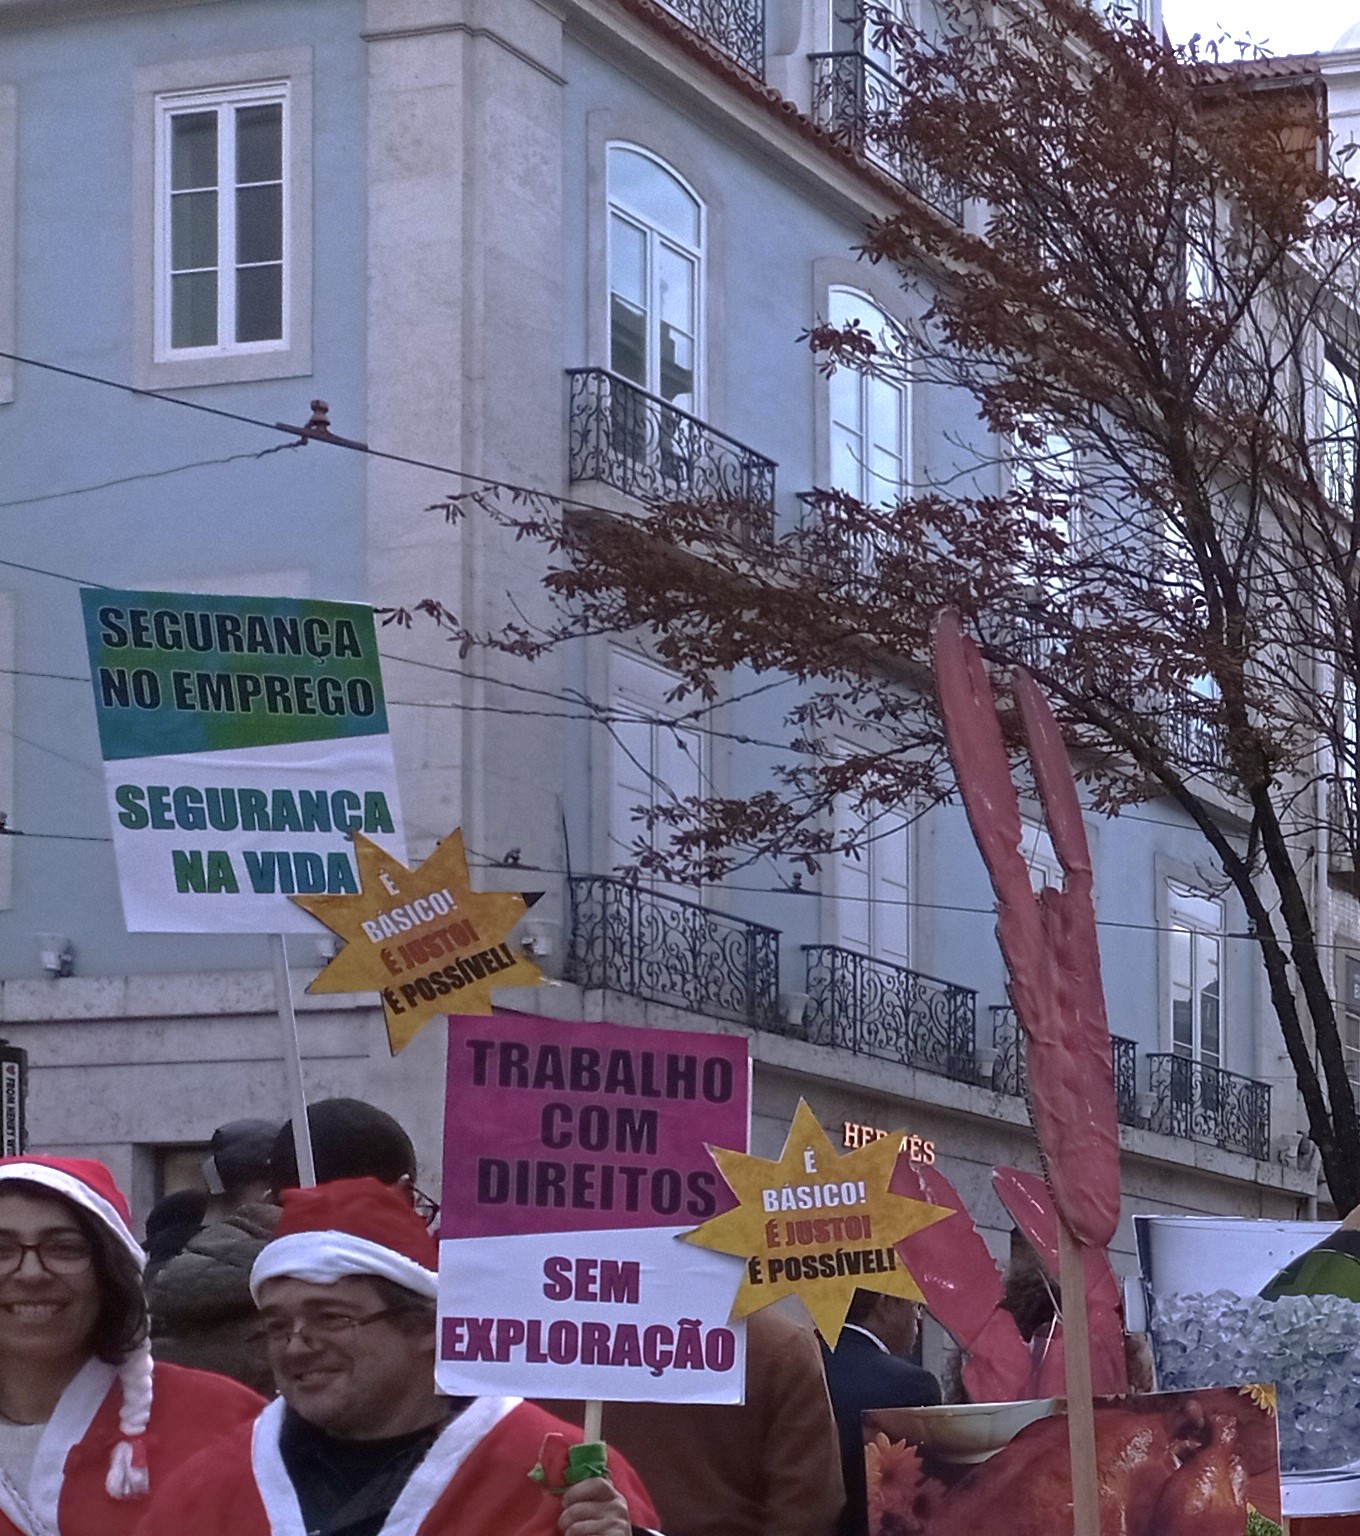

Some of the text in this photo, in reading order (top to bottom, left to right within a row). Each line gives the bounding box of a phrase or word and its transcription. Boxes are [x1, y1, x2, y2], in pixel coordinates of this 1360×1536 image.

[99, 605, 363, 666] SEGURANÇA
[99, 667, 376, 718] NO EMPREGO
[115, 784, 396, 842] SEGURANÇA
[172, 850, 359, 895] NA VIDA
[378, 868, 400, 896] É
[361, 889, 459, 944] BÁSICO!
[380, 919, 480, 977] É JUSTO!
[383, 942, 517, 1016] É POSSÍVEL!
[465, 1038, 735, 1104] TRABALHO
[540, 1101, 659, 1156] COM
[803, 1146, 817, 1174] É
[476, 1157, 717, 1219] DIREITOS
[762, 1181, 866, 1212] BÁSICO!
[765, 1215, 872, 1248] É JUSTO!
[542, 1256, 641, 1305] SEM
[748, 1247, 897, 1285] É POSSÍVEL!
[440, 1317, 736, 1378] EXPLORAÇÃO
